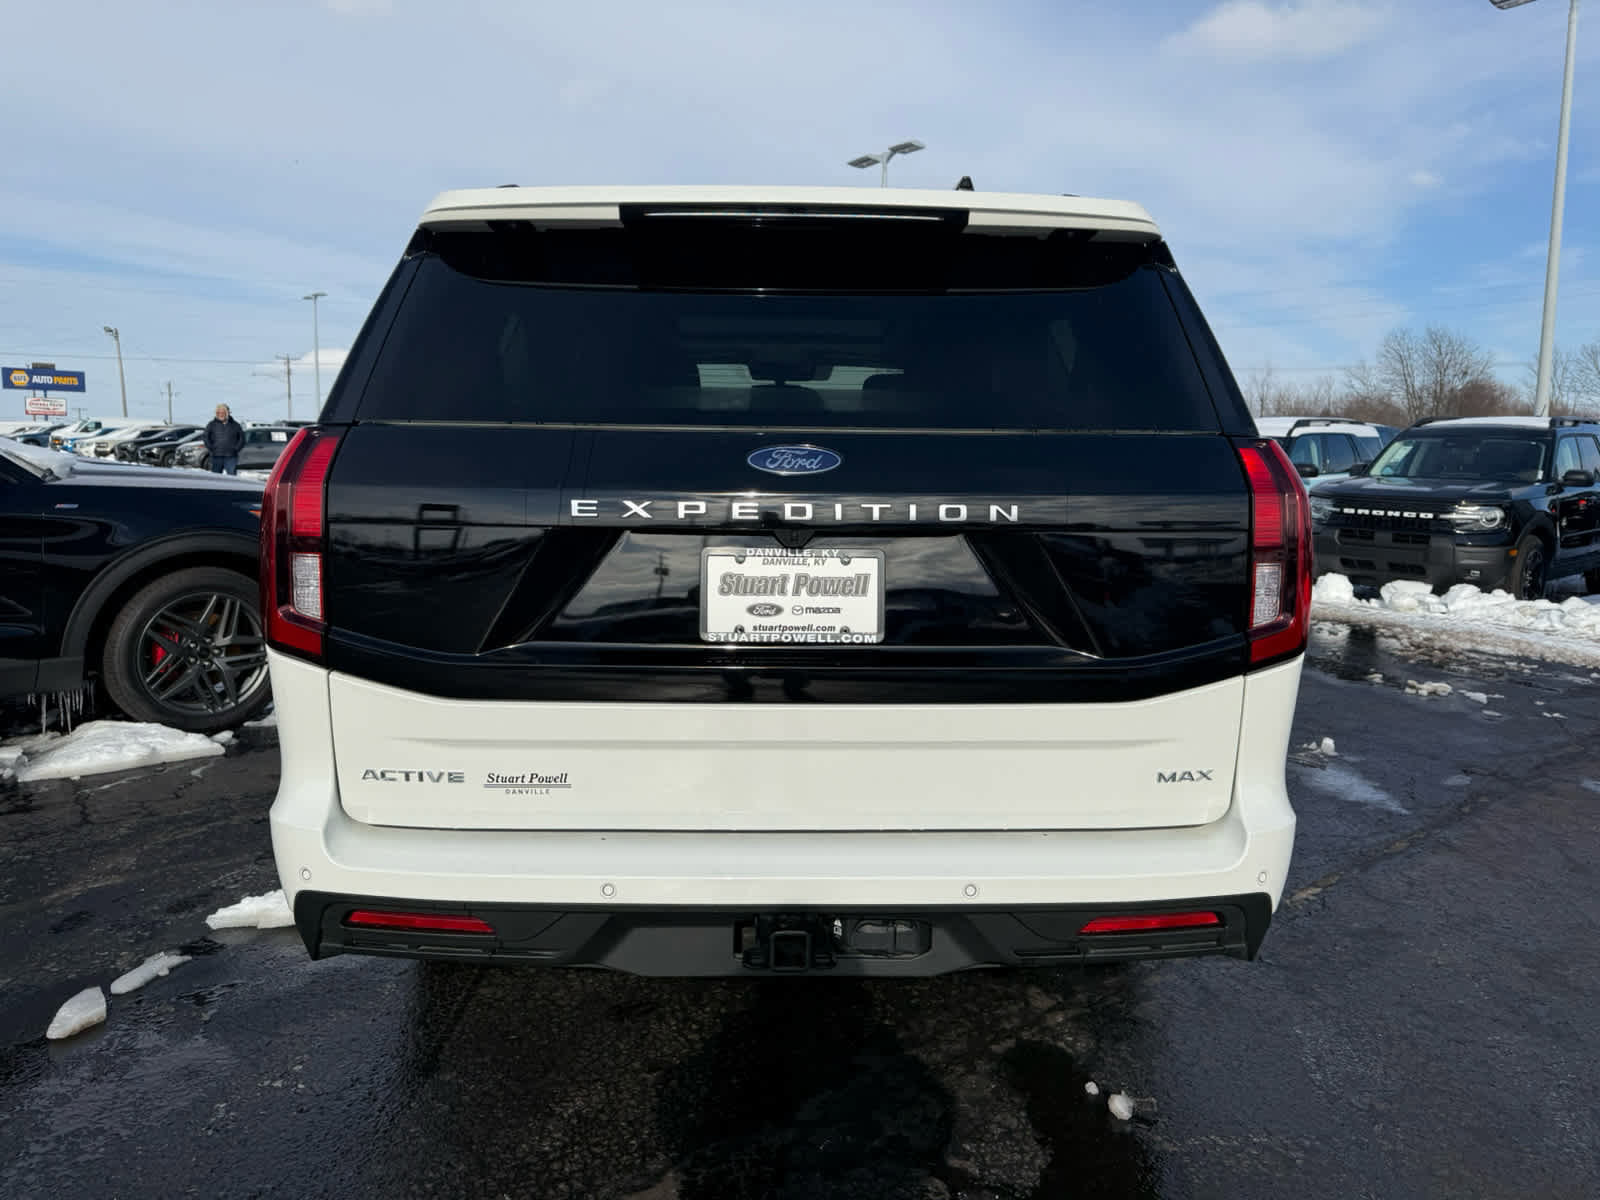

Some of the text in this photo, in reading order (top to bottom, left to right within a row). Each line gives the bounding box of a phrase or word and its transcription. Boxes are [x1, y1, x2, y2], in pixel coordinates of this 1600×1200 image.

[32, 375, 53, 384] AUTO
[53, 376, 79, 385] PARTS
[766, 449, 822, 471] Ford
[570, 499, 1019, 521] EXPEDITION
[1343, 508, 1434, 519] BRONCO
[746, 548, 839, 557] DANVILLE, KY
[762, 558, 827, 567] DANVILLE, KY
[718, 571, 871, 597] Stuart Powell
[753, 604, 776, 615] Ford
[805, 606, 841, 614] mazda
[752, 624, 836, 632] stuartpowell.com
[707, 633, 877, 643] STUARTPOWELL.COM
[361, 769, 465, 783] ACTIVE
[486, 772, 568, 784] Stuart Powell
[1157, 769, 1214, 783] MAX
